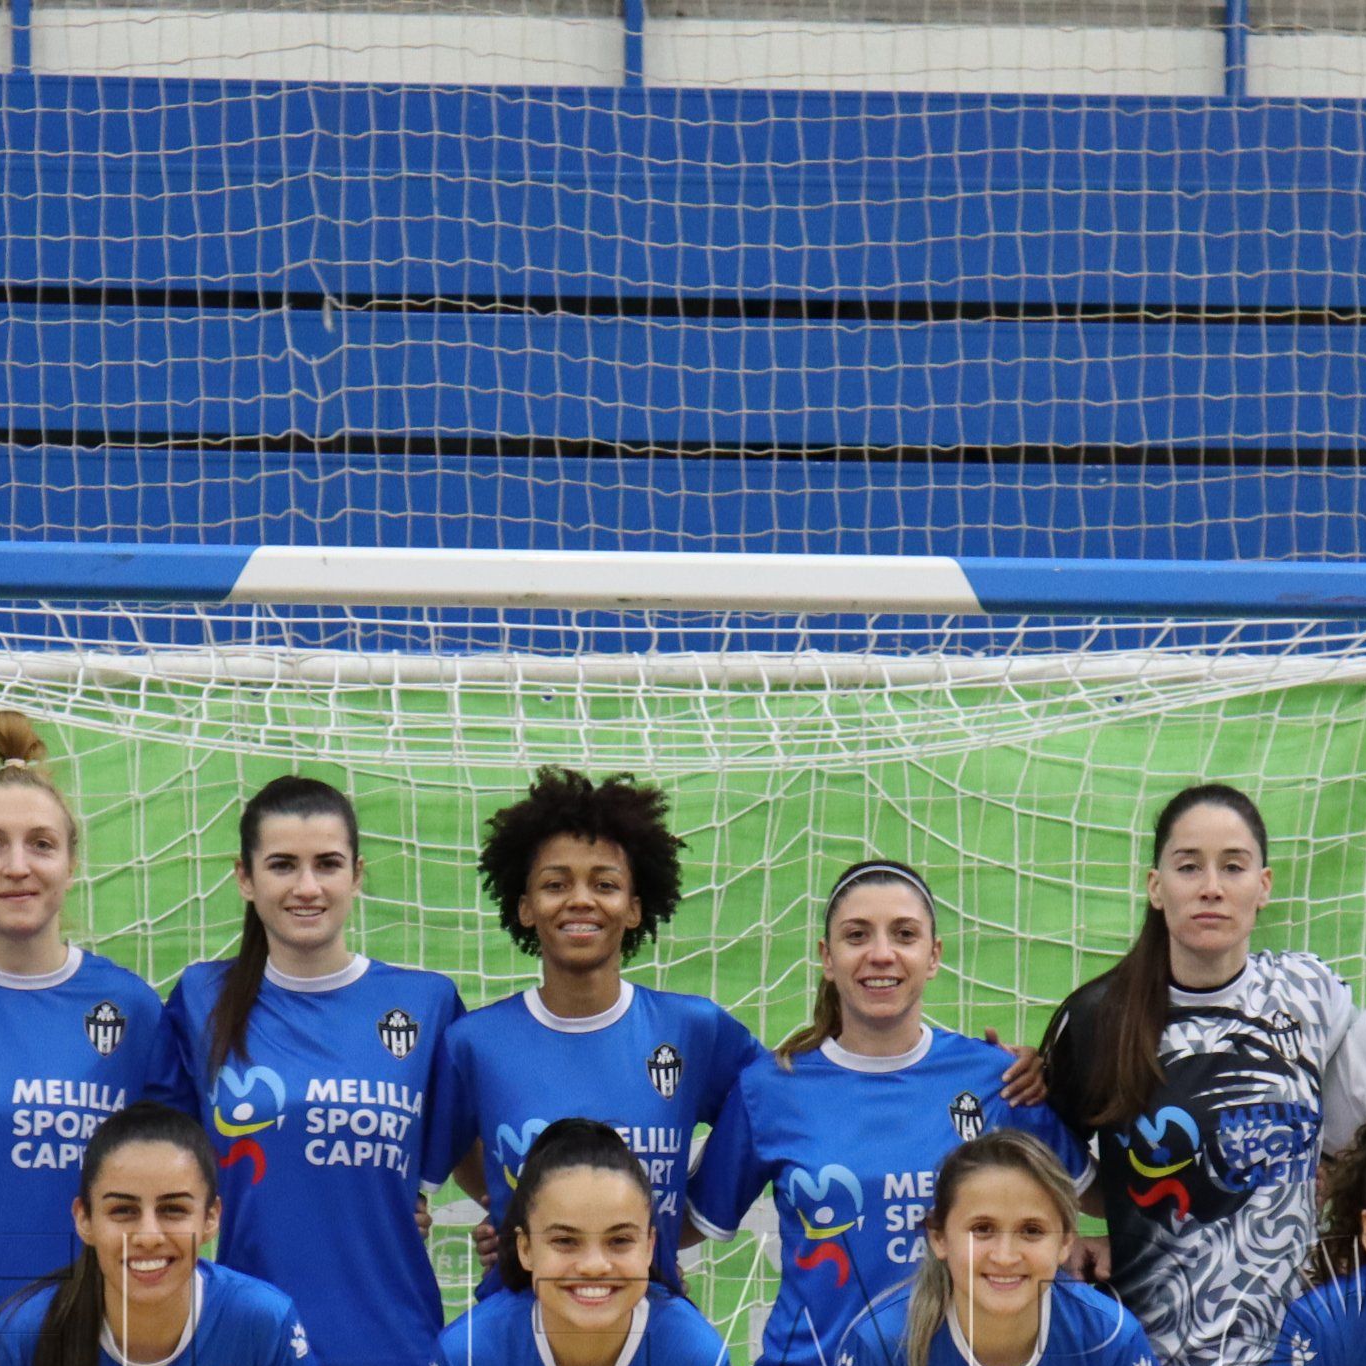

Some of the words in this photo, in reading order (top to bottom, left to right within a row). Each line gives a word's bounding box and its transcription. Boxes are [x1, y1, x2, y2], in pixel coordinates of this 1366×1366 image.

[12, 1078, 127, 1112] MELILLA
[305, 1078, 423, 1119] MELILLA
[305, 1107, 412, 1142] SPORT
